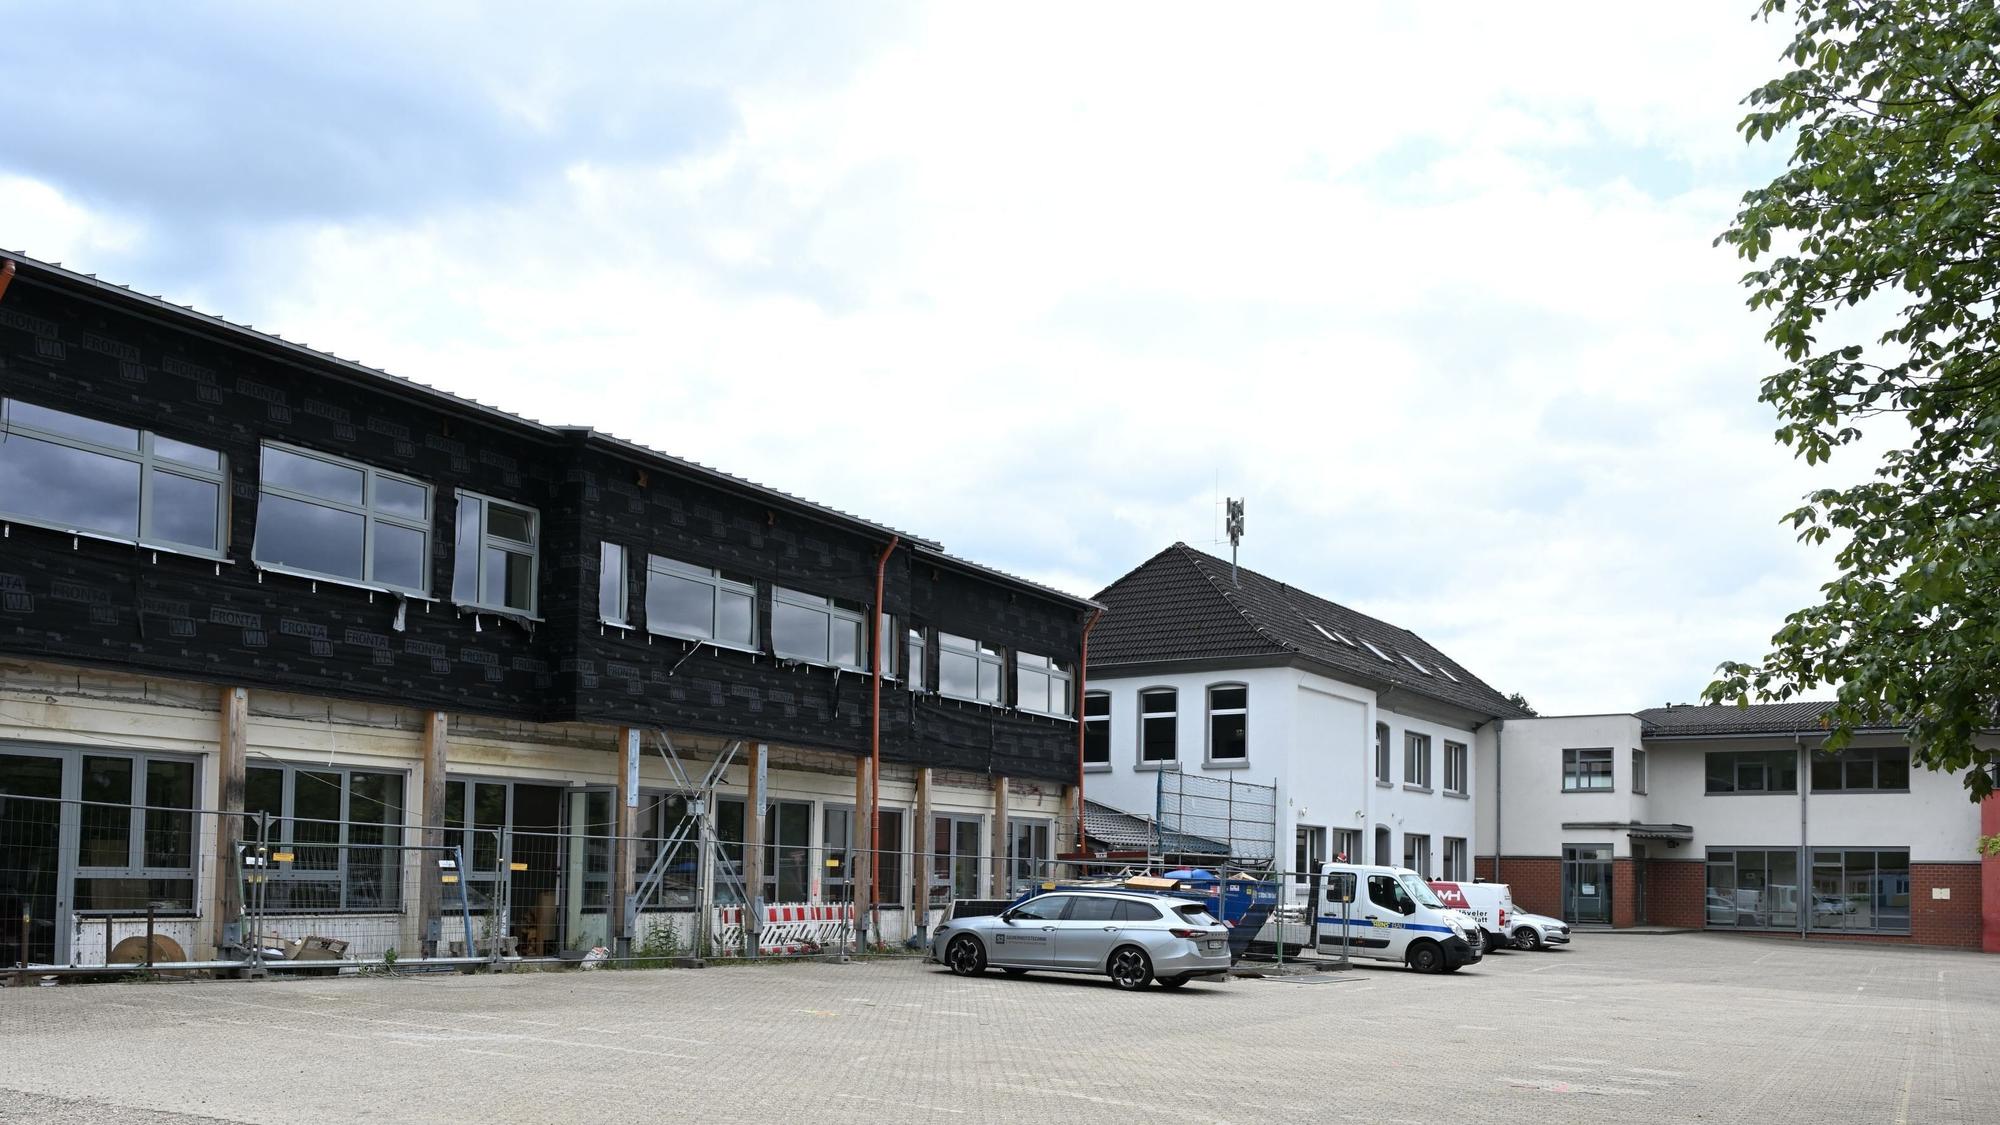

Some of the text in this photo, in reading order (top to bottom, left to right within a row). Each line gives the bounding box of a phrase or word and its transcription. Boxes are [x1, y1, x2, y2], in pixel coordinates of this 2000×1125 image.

[122, 362, 145, 380] WA
[199, 385, 220, 401] WA
[270, 402, 289, 421] WA
[7, 594, 31, 609] WA
[212, 609, 259, 628] FRONTA
[171, 619, 193, 634] WA
[282, 620, 326, 638] FRONTA
[245, 630, 265, 644] WA
[347, 630, 387, 648] FRONTA
[406, 641, 444, 656] FRONTA
[462, 650, 498, 665] FRONTA
[486, 665, 502, 680] WA
[1437, 890, 1461, 901] MH
